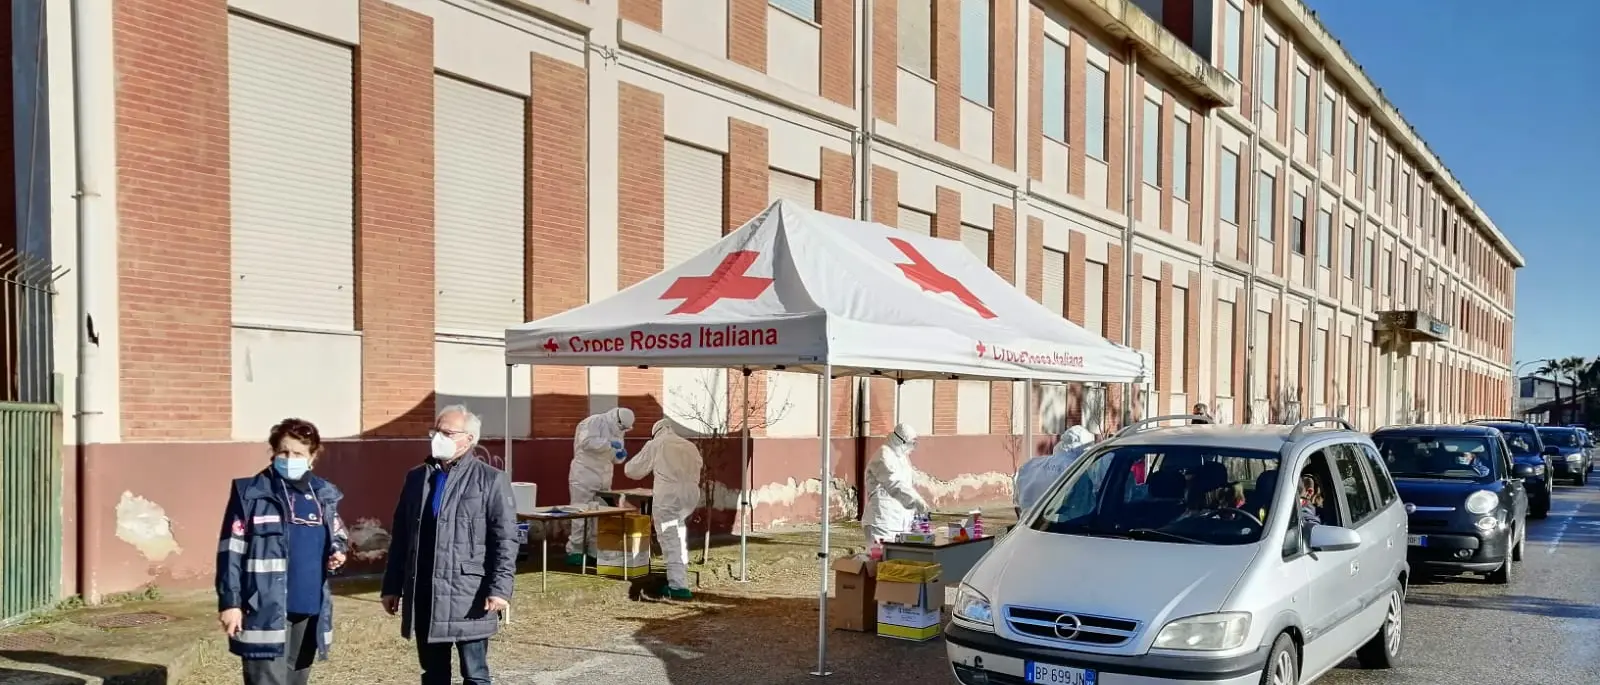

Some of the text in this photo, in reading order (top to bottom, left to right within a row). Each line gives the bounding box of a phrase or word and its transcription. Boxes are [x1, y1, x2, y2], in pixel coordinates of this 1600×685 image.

[568, 324, 778, 353] Croce Rossa Italiana
[1035, 666, 1048, 681] BP
[1051, 668, 1071, 684] 699
